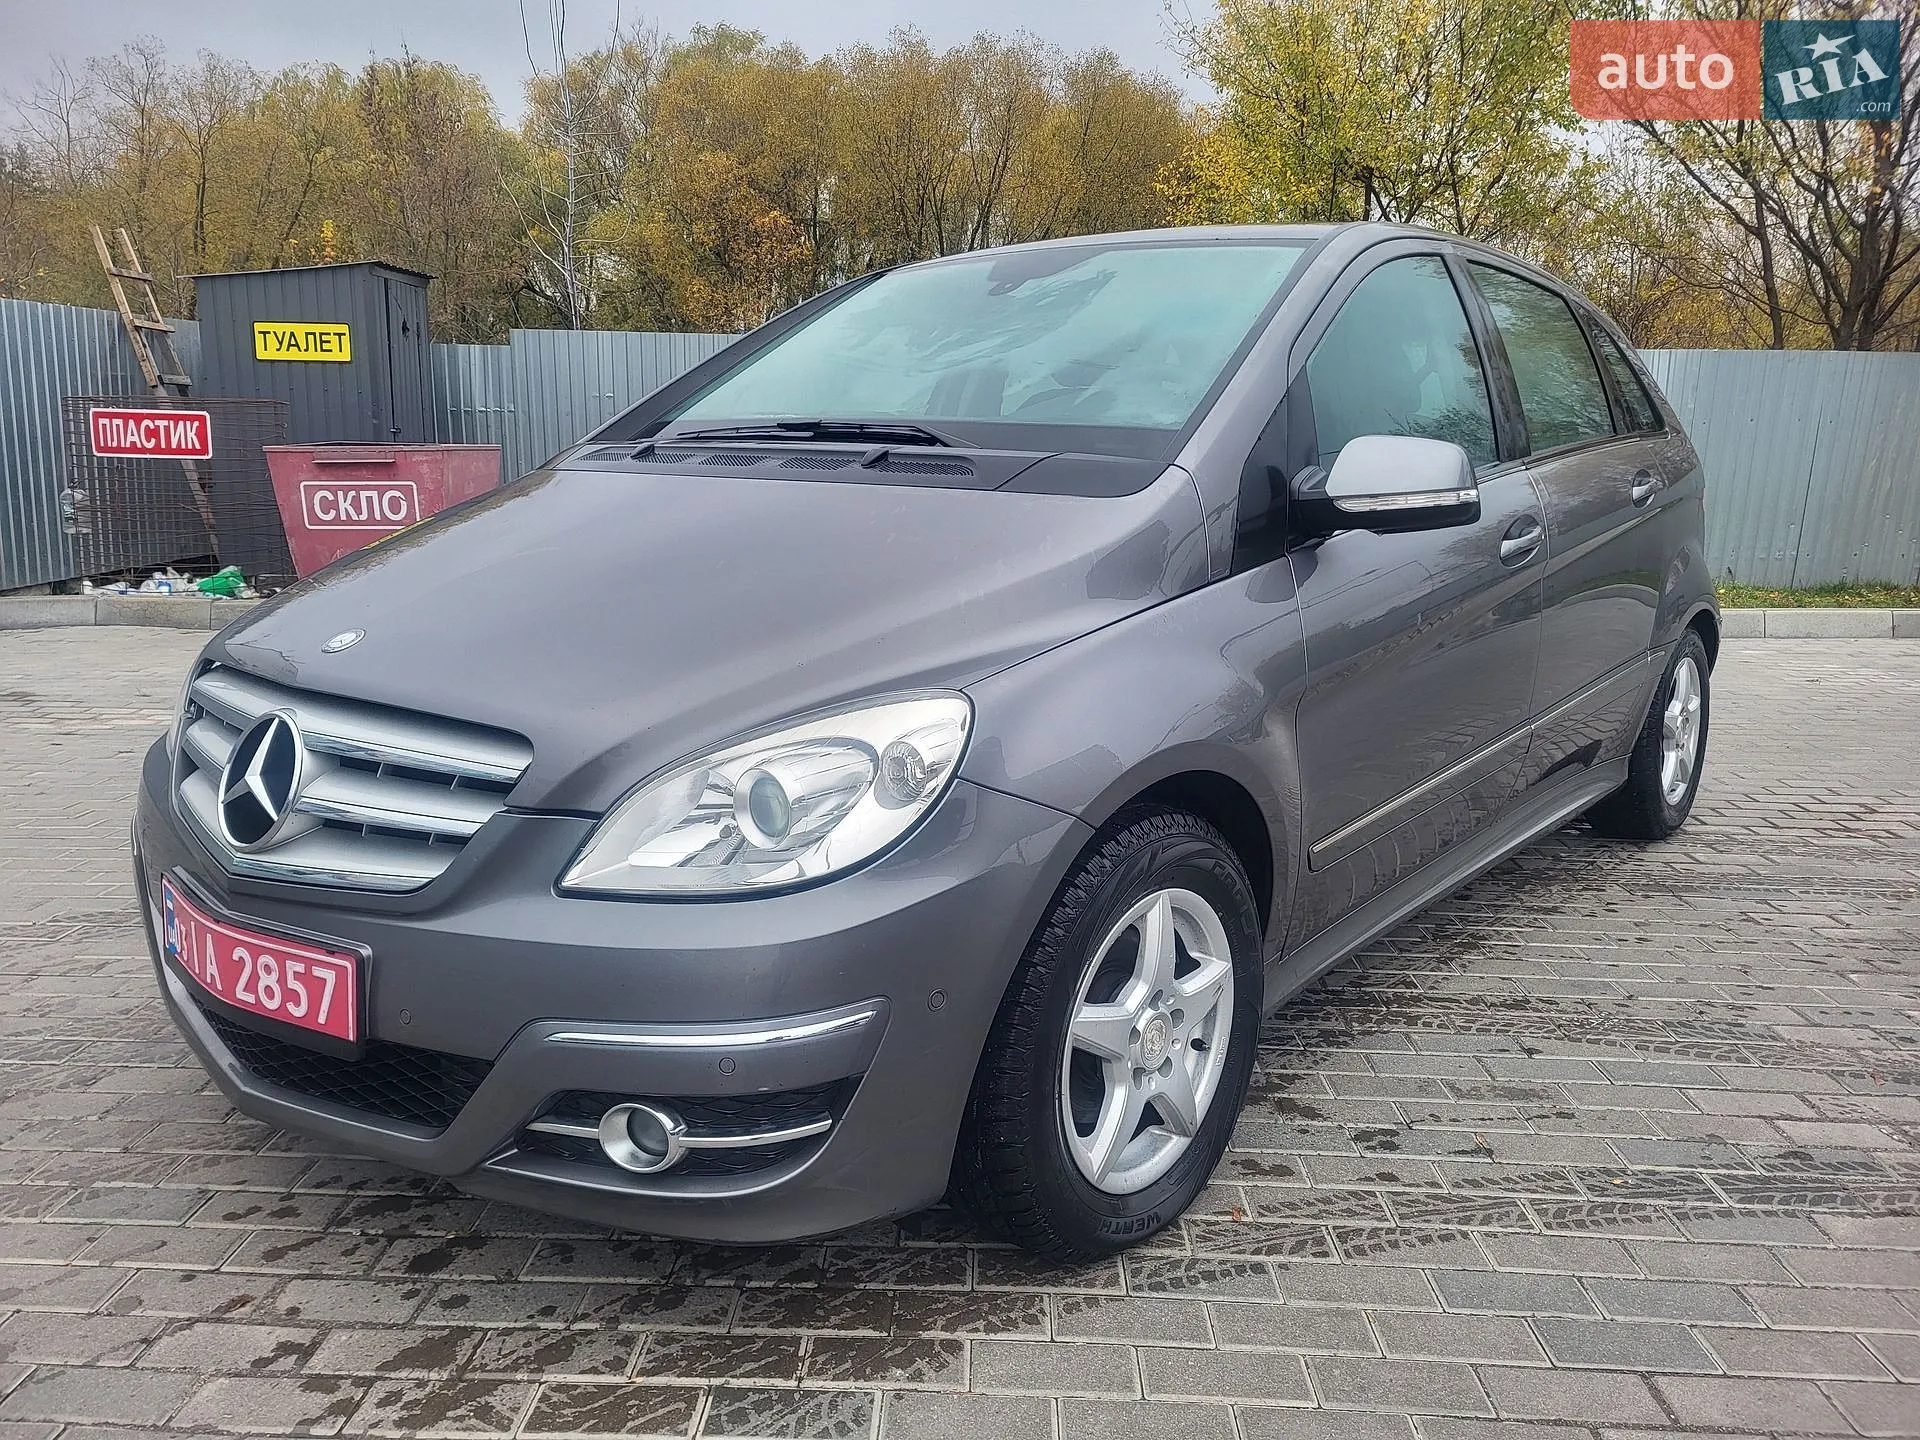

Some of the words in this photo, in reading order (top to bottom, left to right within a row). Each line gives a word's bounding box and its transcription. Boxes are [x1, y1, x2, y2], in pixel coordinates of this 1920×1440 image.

[258, 330, 346, 353] ТУАЛЕТ
[97, 417, 201, 450] ПЛАСТИК
[313, 489, 407, 522] СКЛО
[232, 946, 336, 1025] 2857
